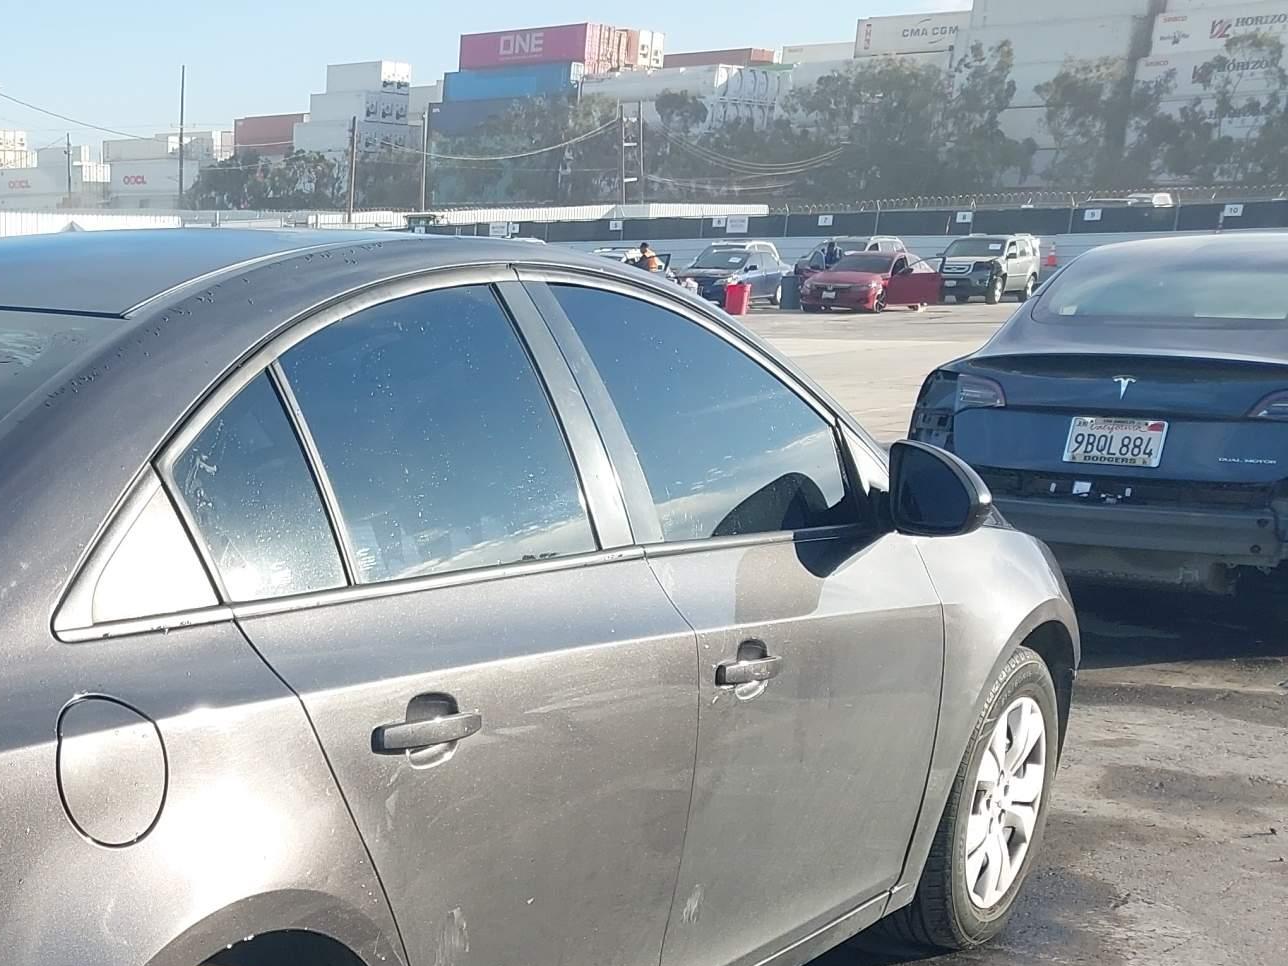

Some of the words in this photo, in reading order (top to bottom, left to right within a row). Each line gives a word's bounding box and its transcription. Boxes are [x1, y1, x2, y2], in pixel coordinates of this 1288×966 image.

[902, 28, 928, 38] CMA
[932, 25, 959, 36] CGM
[498, 32, 544, 55] ONE
[8, 180, 31, 189] OOCL
[123, 175, 147, 185] OOCL
[1072, 433, 1153, 458] 9BQL884
[1083, 455, 1136, 464] DODGERS
